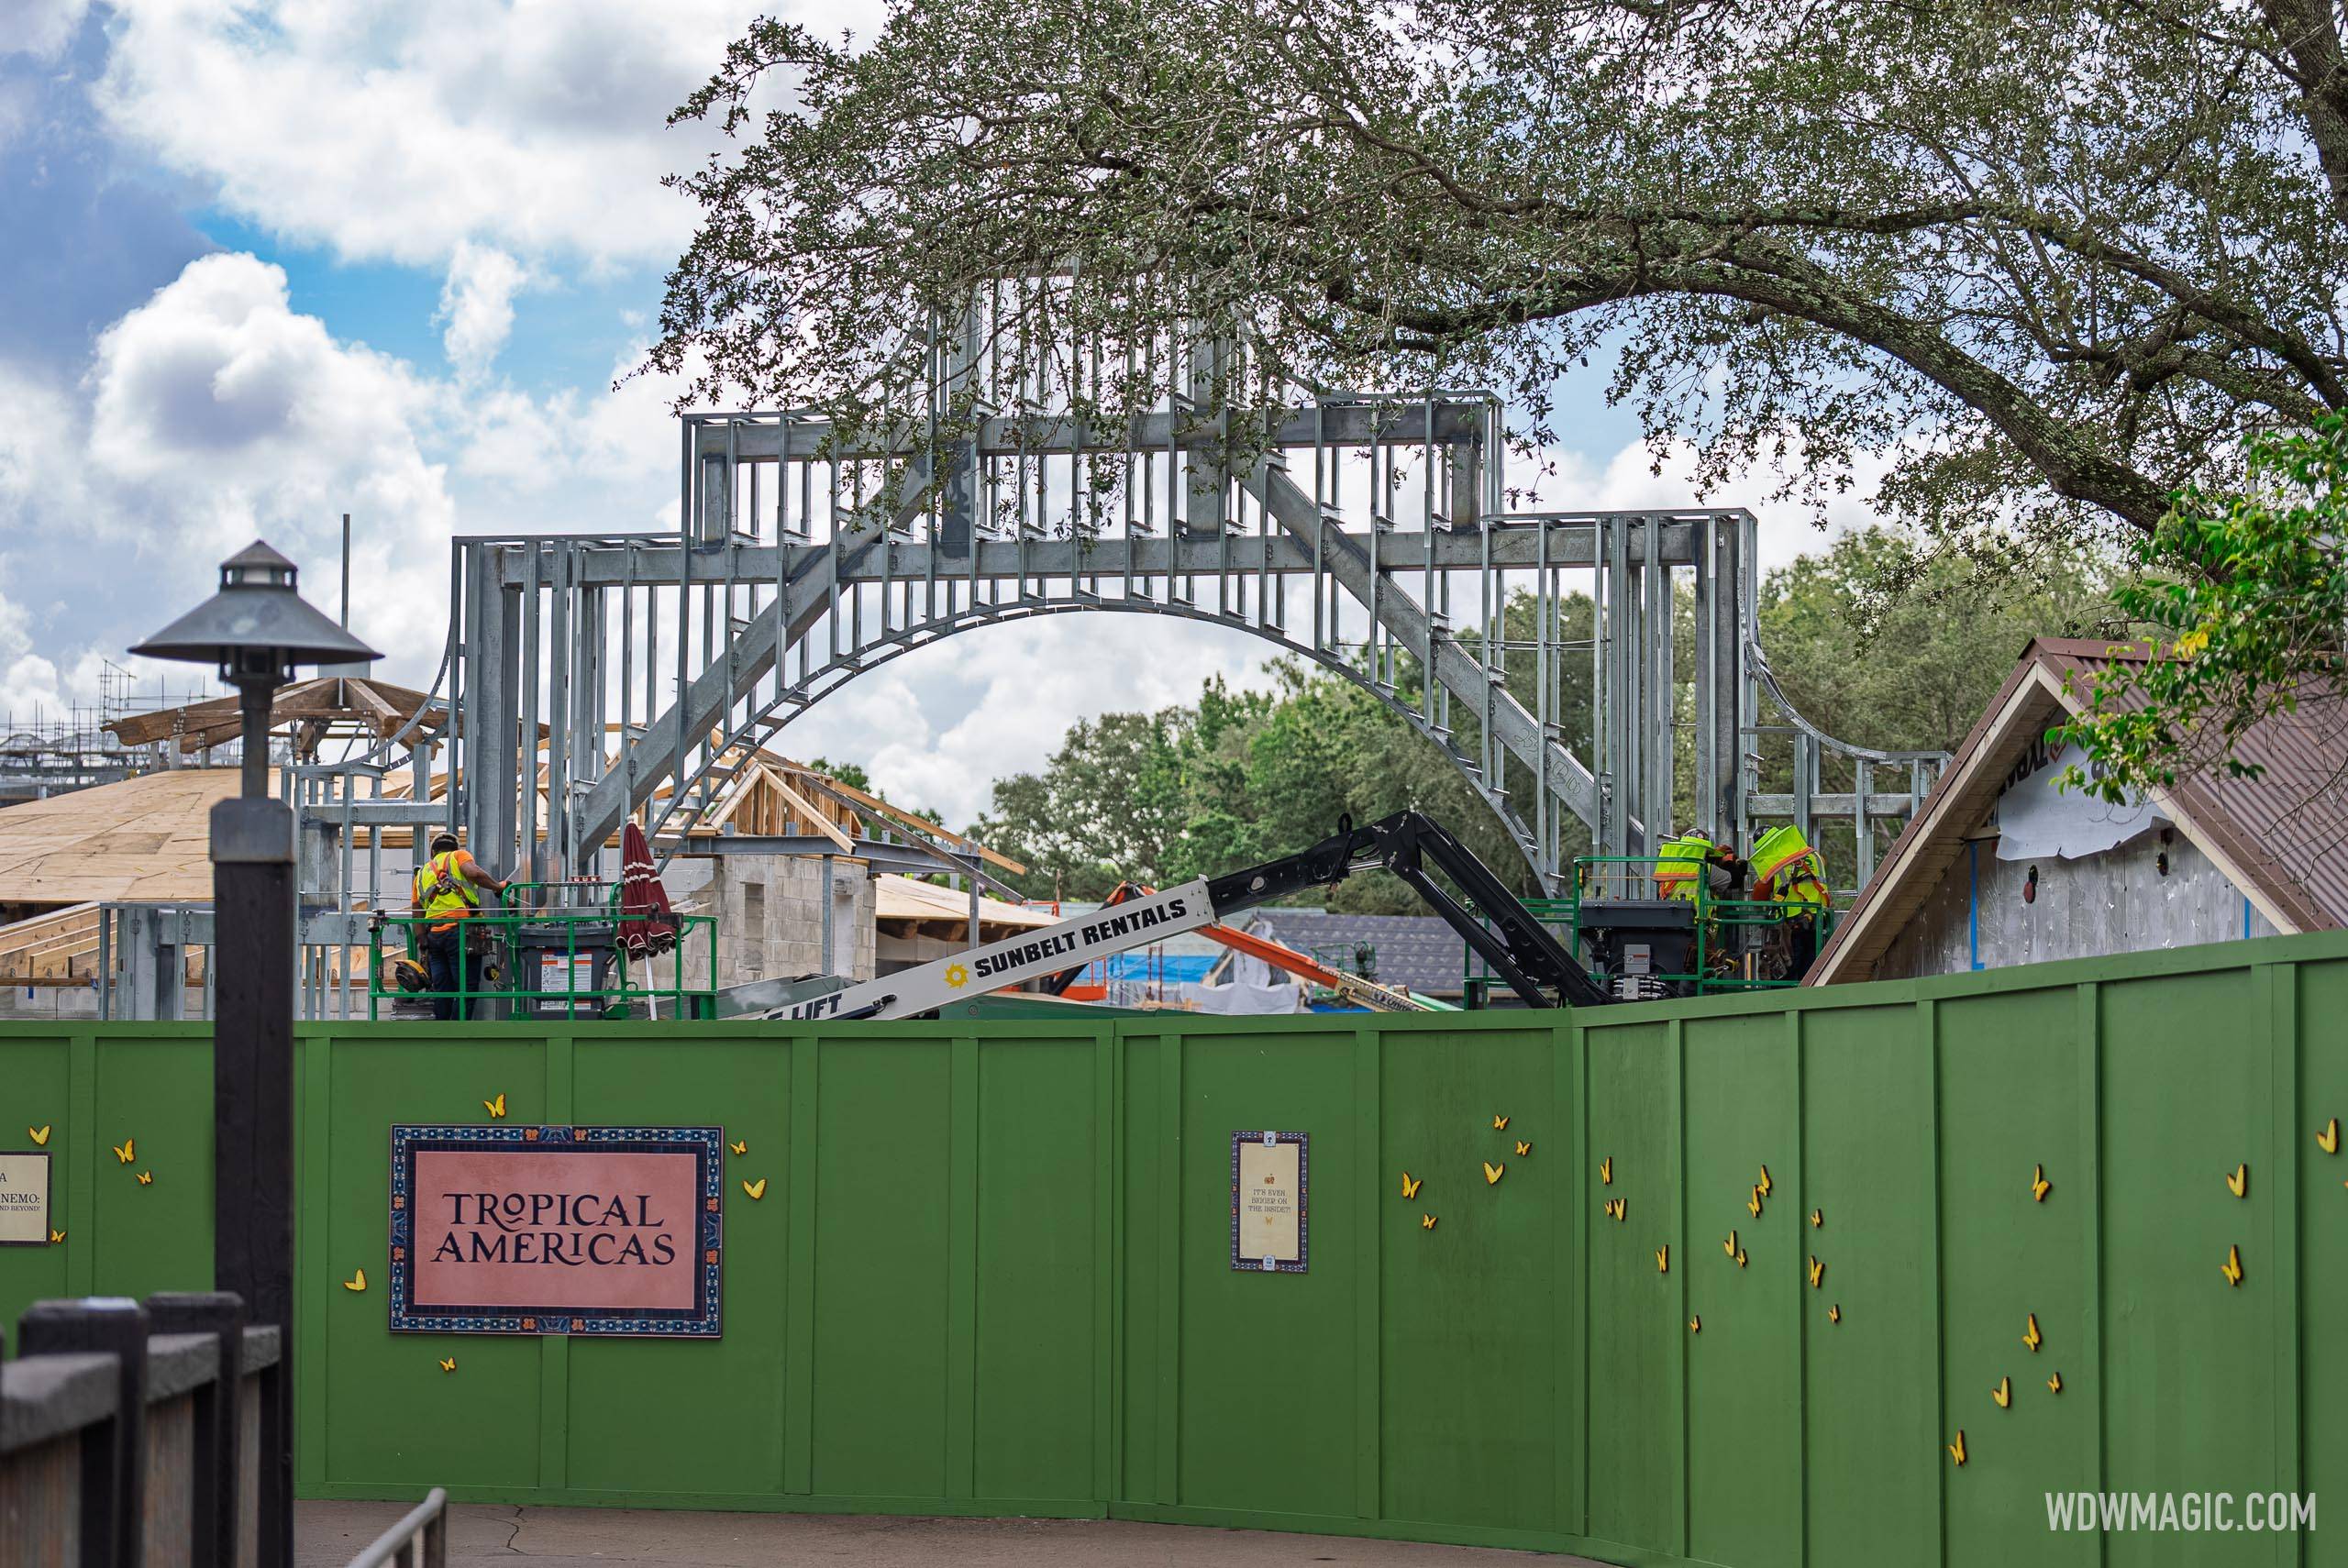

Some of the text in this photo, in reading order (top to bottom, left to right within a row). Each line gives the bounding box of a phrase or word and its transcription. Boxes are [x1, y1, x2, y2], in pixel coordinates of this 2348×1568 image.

[975, 899, 1187, 977] SUNBELT RENTALS
[792, 993, 842, 1020] LIFT
[1, 1193, 40, 1204] NEMO:
[442, 1193, 664, 1232] TROPICAL
[1278, 1197, 1288, 1205] ON
[430, 1231, 675, 1265] AMERICAS
